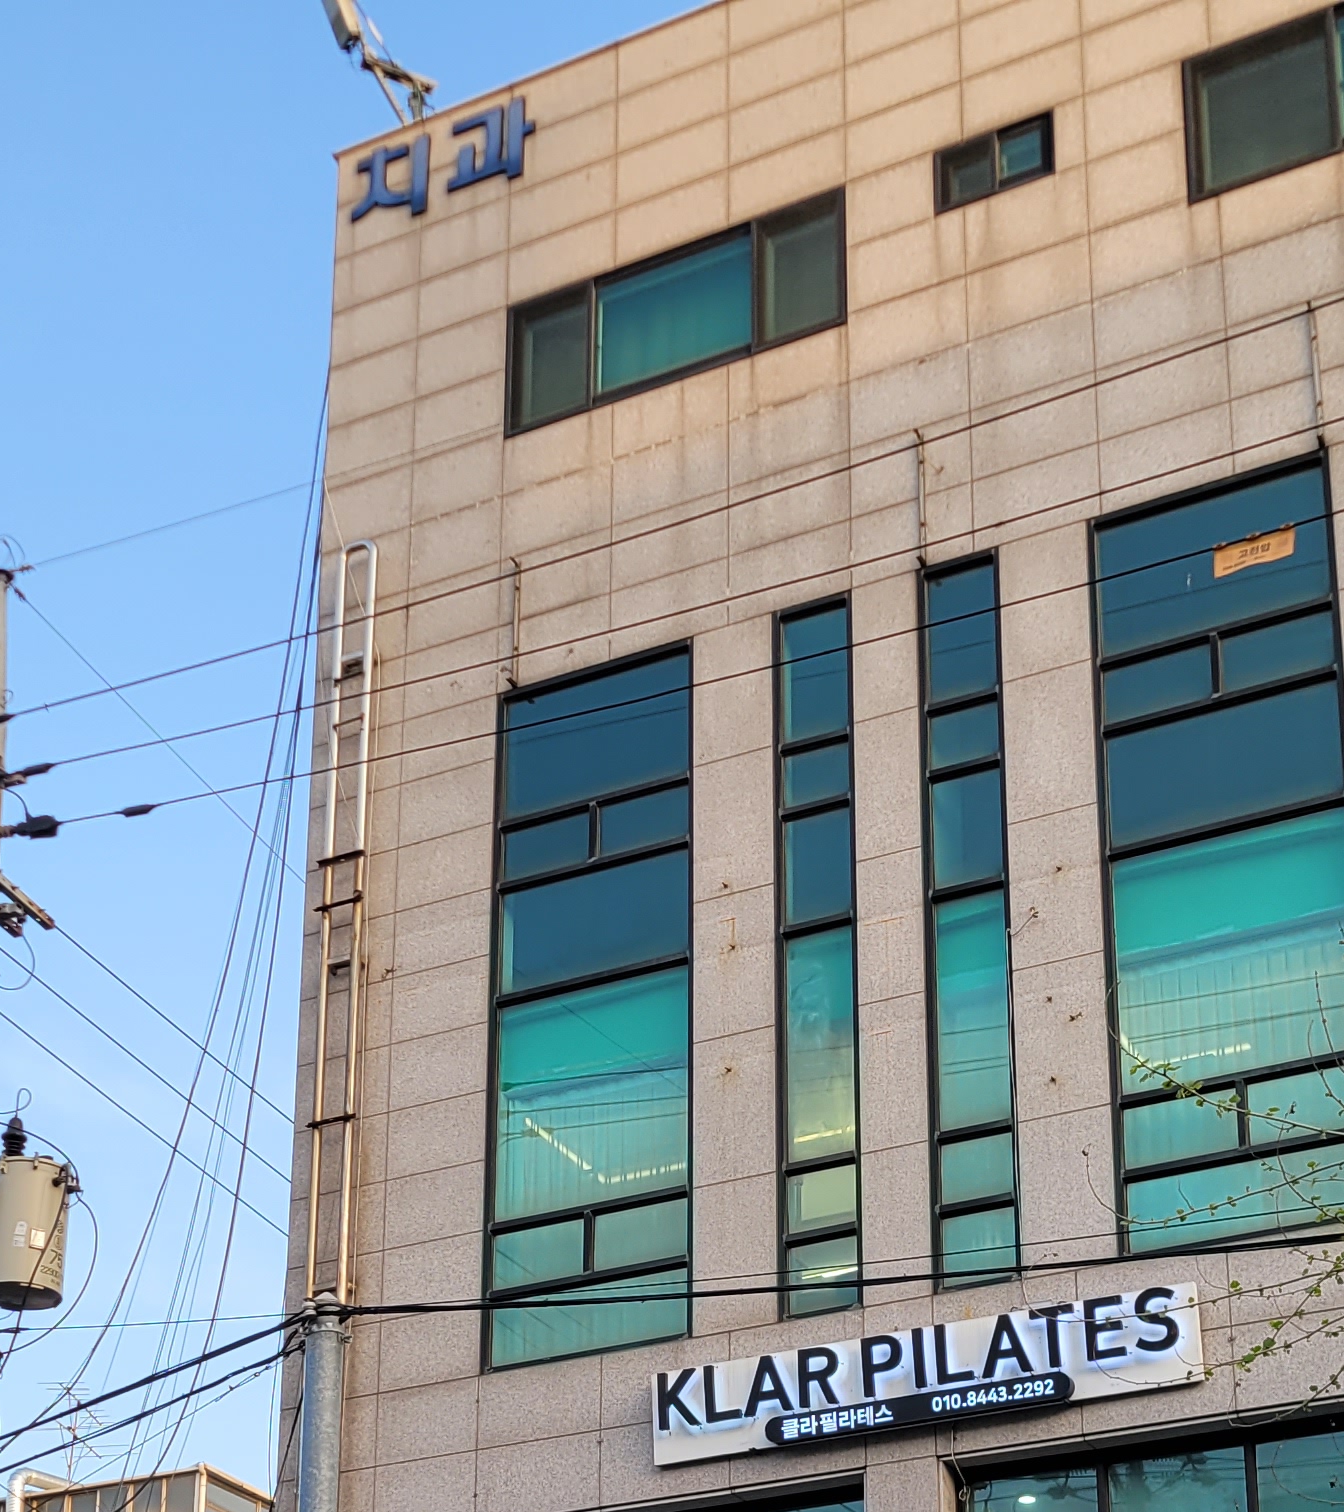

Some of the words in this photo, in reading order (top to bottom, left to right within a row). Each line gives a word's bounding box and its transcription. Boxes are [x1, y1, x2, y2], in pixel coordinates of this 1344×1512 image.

[351, 95, 536, 224] 치과
[657, 1346, 842, 1431] KLAR
[861, 1286, 1181, 1398] PILATES
[780, 1405, 894, 1440] 클라필라테스
[930, 1378, 1055, 1413] 010.8443.2292
